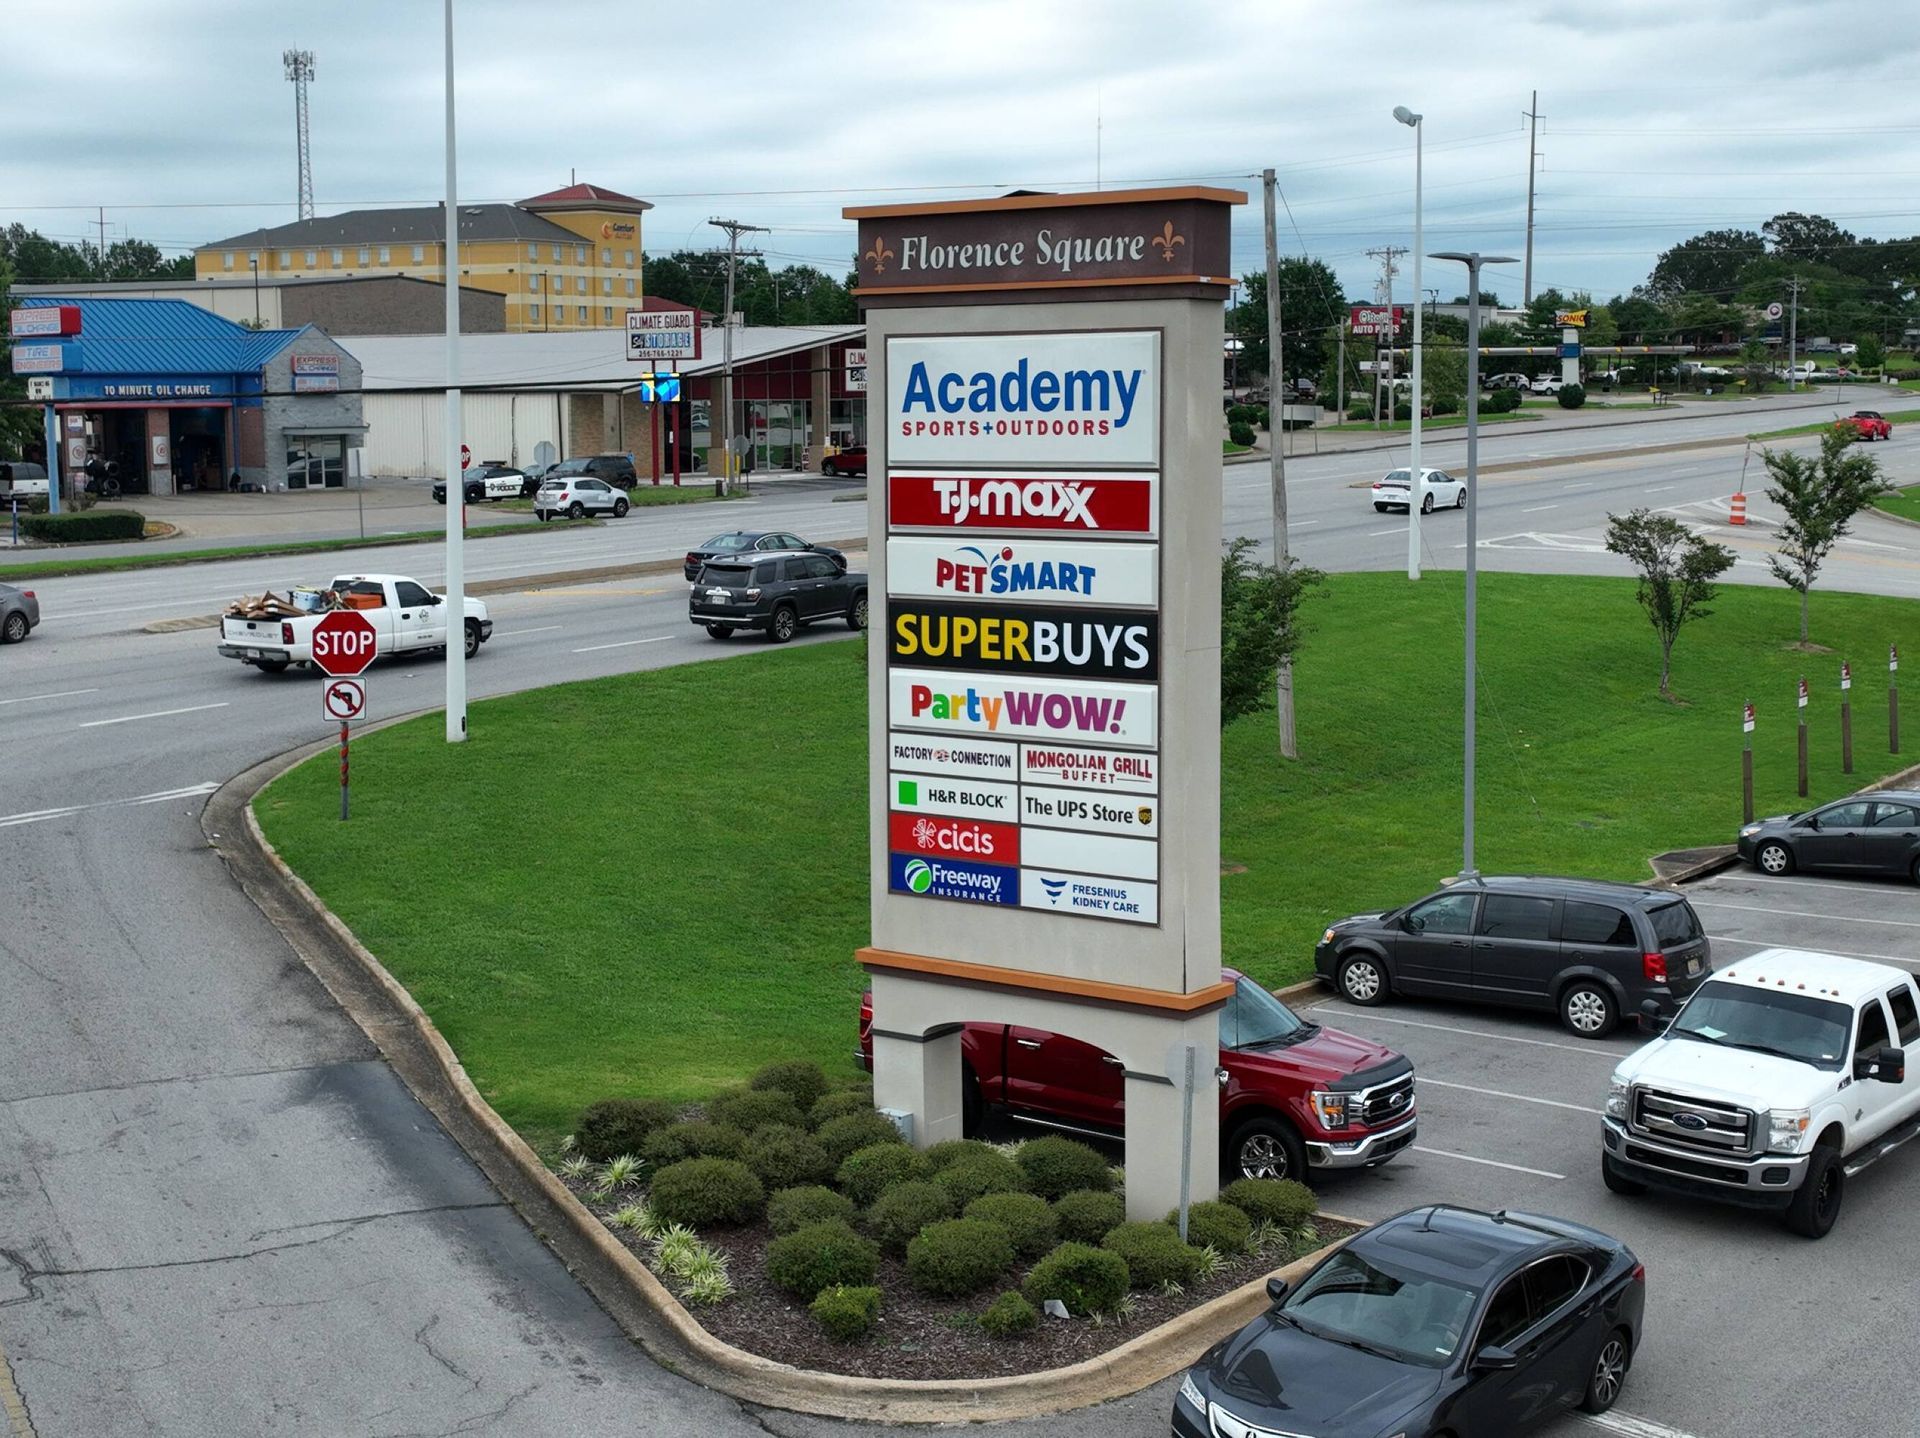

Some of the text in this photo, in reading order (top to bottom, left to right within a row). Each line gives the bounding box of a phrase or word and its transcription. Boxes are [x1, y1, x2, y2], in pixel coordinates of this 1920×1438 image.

[900, 229, 1145, 272] Florence Square
[630, 314, 690, 329] CLIMATE GUARD
[1557, 314, 1584, 322] SONIC
[1353, 325, 1373, 334] AUTO
[645, 332, 690, 348] STORAGE
[27, 347, 48, 357] TIRE
[104, 384, 211, 395] 10 MINUTE OIL CHANGE
[902, 357, 1142, 428] Academy
[902, 419, 1110, 436] SPORTS+OUTDOORS
[315, 631, 374, 656] STOP
[894, 745, 933, 760] FACTORY
[951, 750, 1011, 768] CONNECTION
[1027, 750, 1152, 779] MONGOLIAN GRILL
[1062, 770, 1115, 784] BUFFET
[928, 788, 1004, 808] H&R BLOCK
[1025, 797, 1133, 824] The UPS Store
[937, 823, 994, 854] cicis
[932, 863, 1001, 894] Freeway
[932, 886, 1001, 903] INSURANCE
[1072, 884, 1127, 899] FRESENIUS
[1072, 897, 1139, 914] KIDNEY CARE
